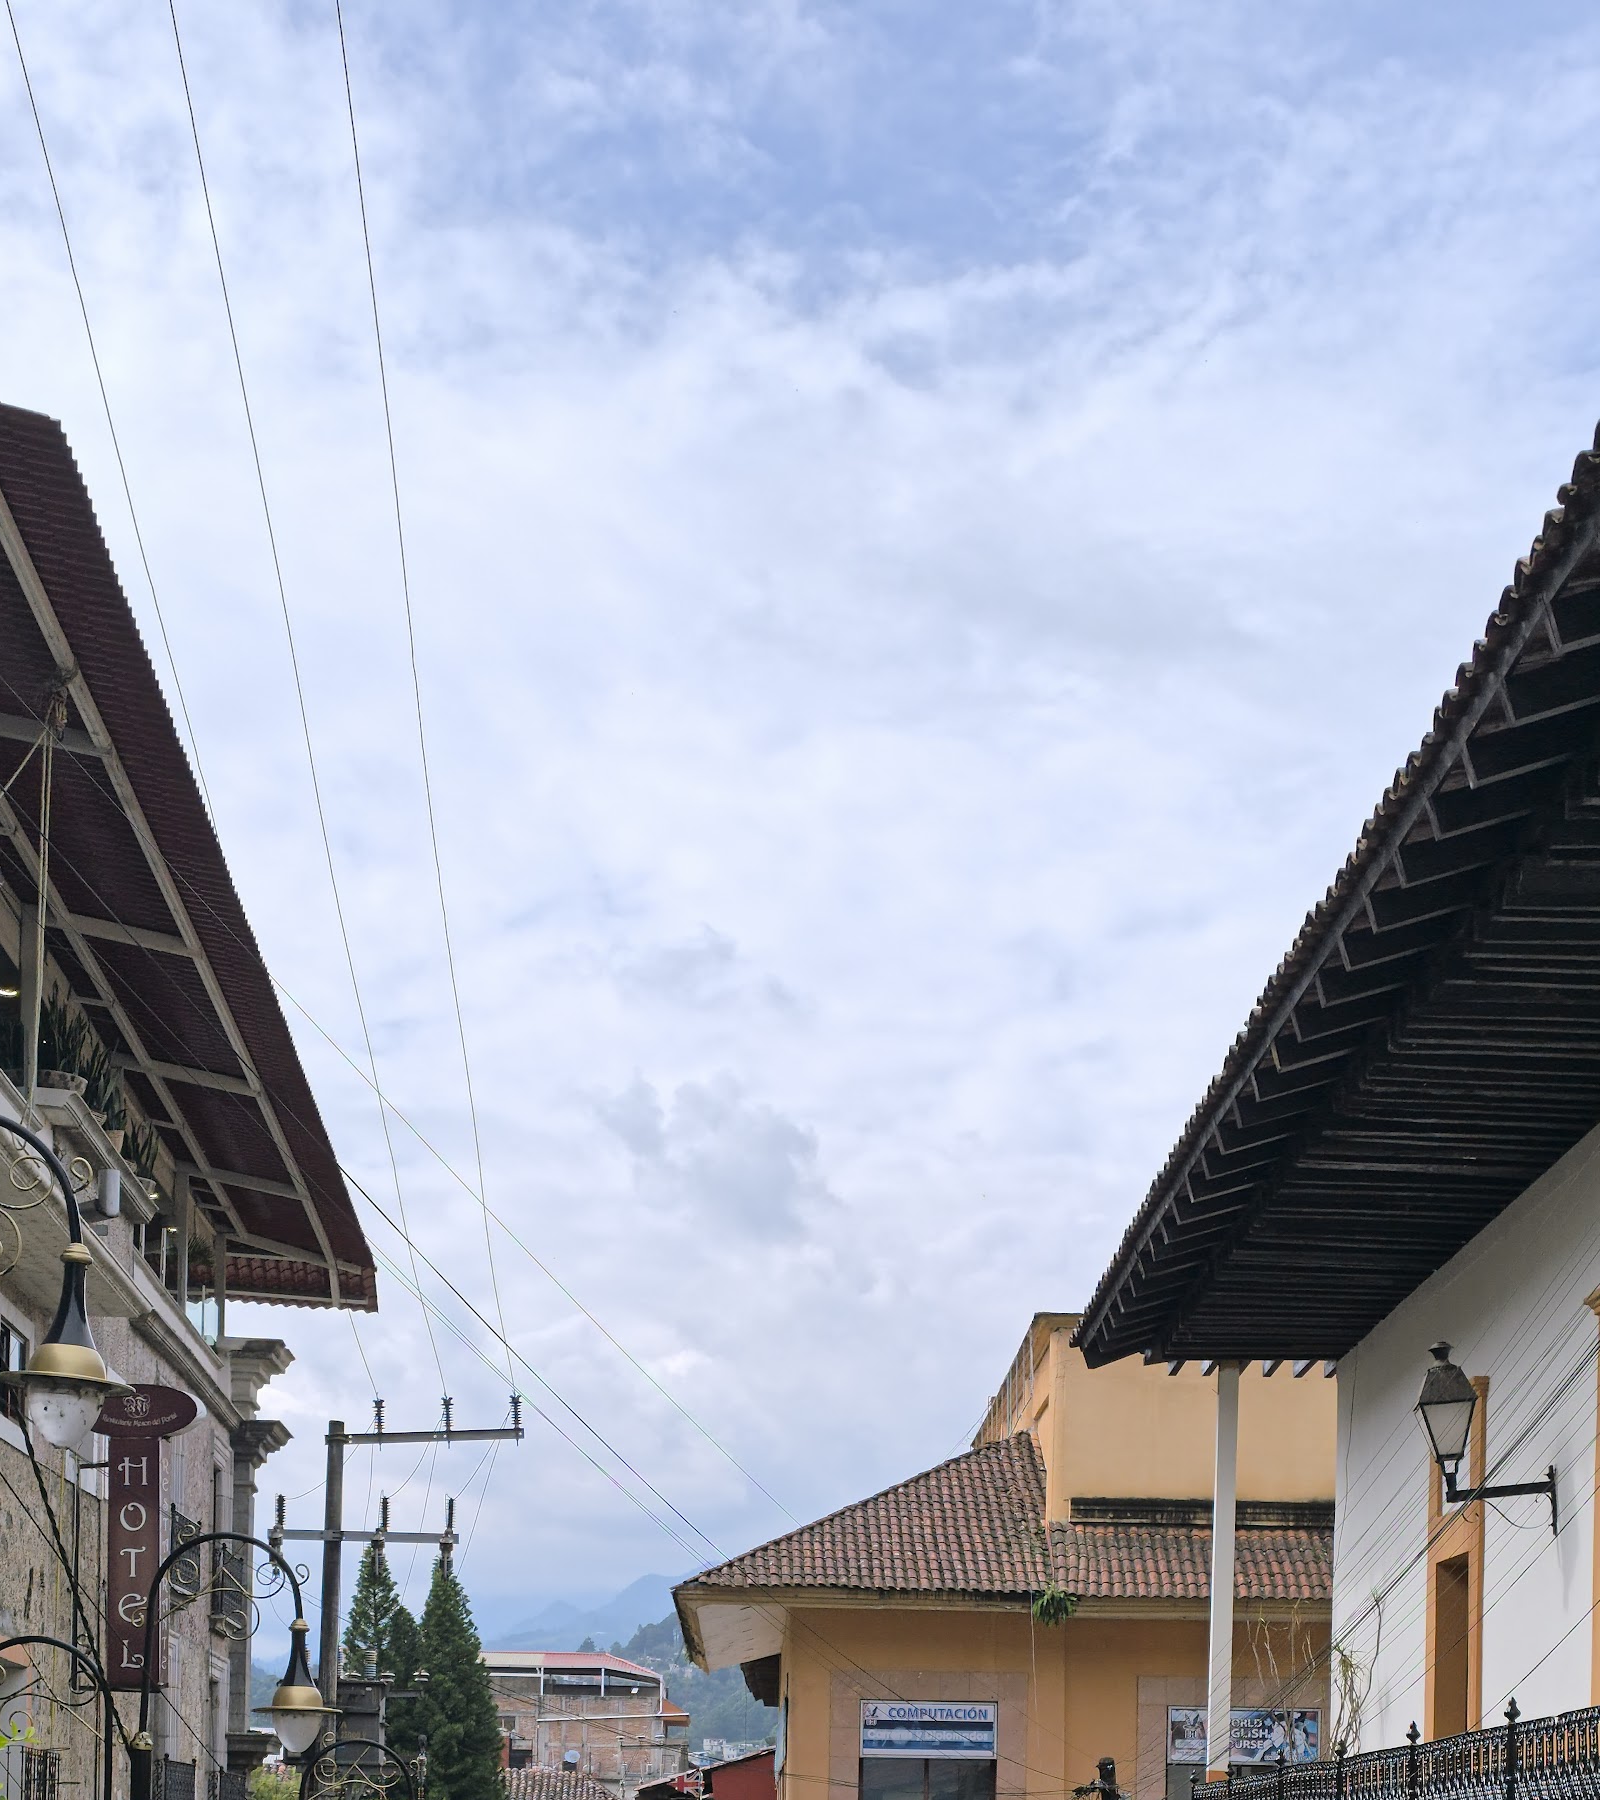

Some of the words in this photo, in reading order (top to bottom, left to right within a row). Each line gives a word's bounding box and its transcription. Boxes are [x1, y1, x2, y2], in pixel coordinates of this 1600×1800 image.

[117, 1456, 148, 1669] HOTEL
[888, 1706, 989, 1720] COMPUTACIÓN
[1229, 1718, 1263, 1728] ORLD
[1229, 1728, 1269, 1738] GLISH
